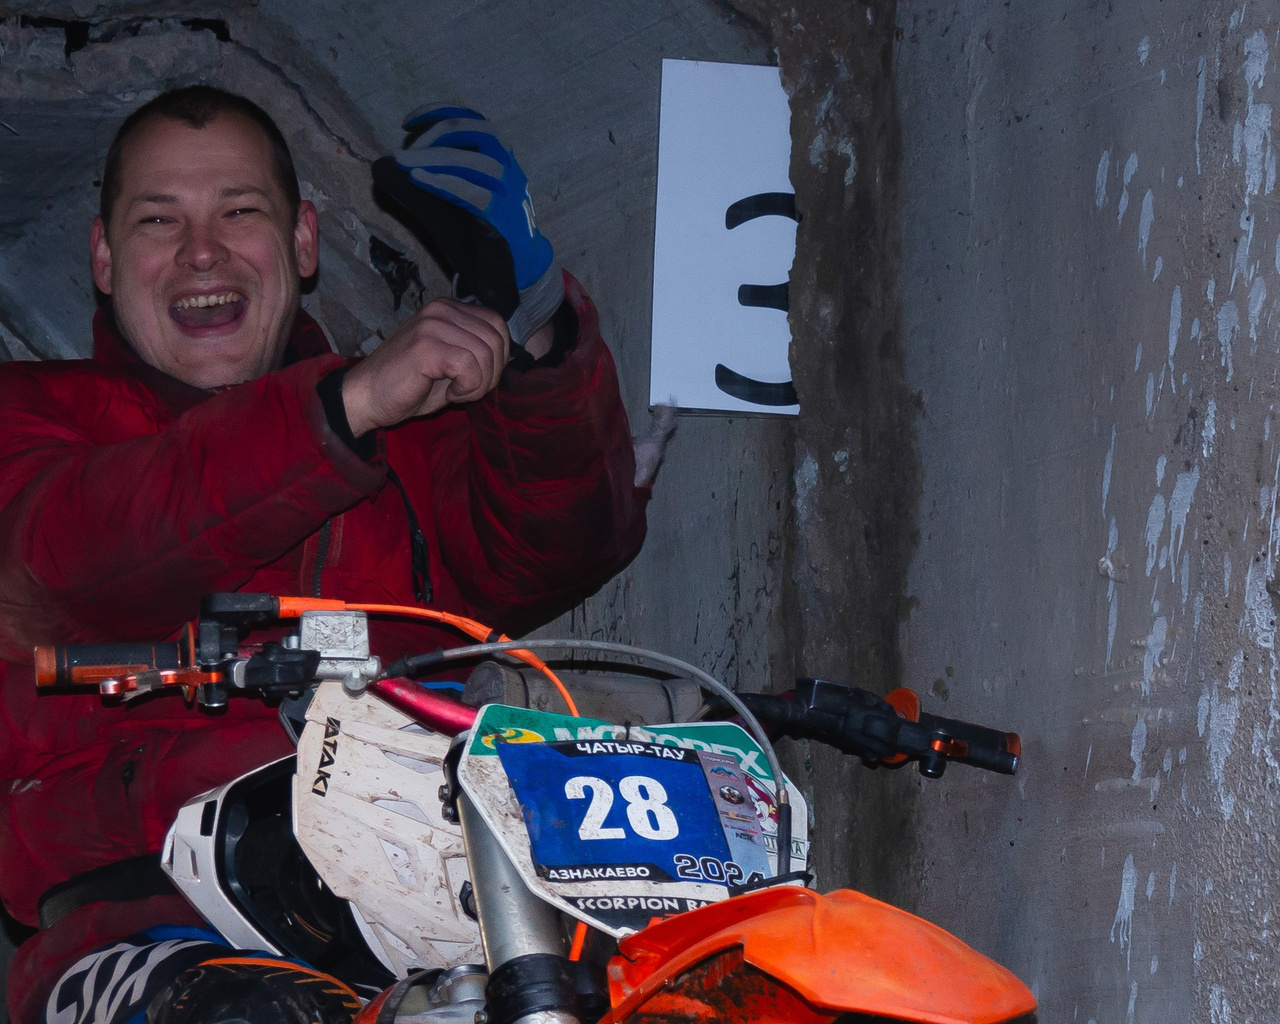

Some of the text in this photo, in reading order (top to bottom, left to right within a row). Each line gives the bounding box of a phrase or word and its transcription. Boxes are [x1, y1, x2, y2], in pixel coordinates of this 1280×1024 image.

[576, 742, 685, 761] ЧАТЫР-ТАУ
[564, 775, 680, 841] 28
[548, 866, 650, 880] АЗНАКАЕВО
[576, 897, 680, 911] SCORPION
